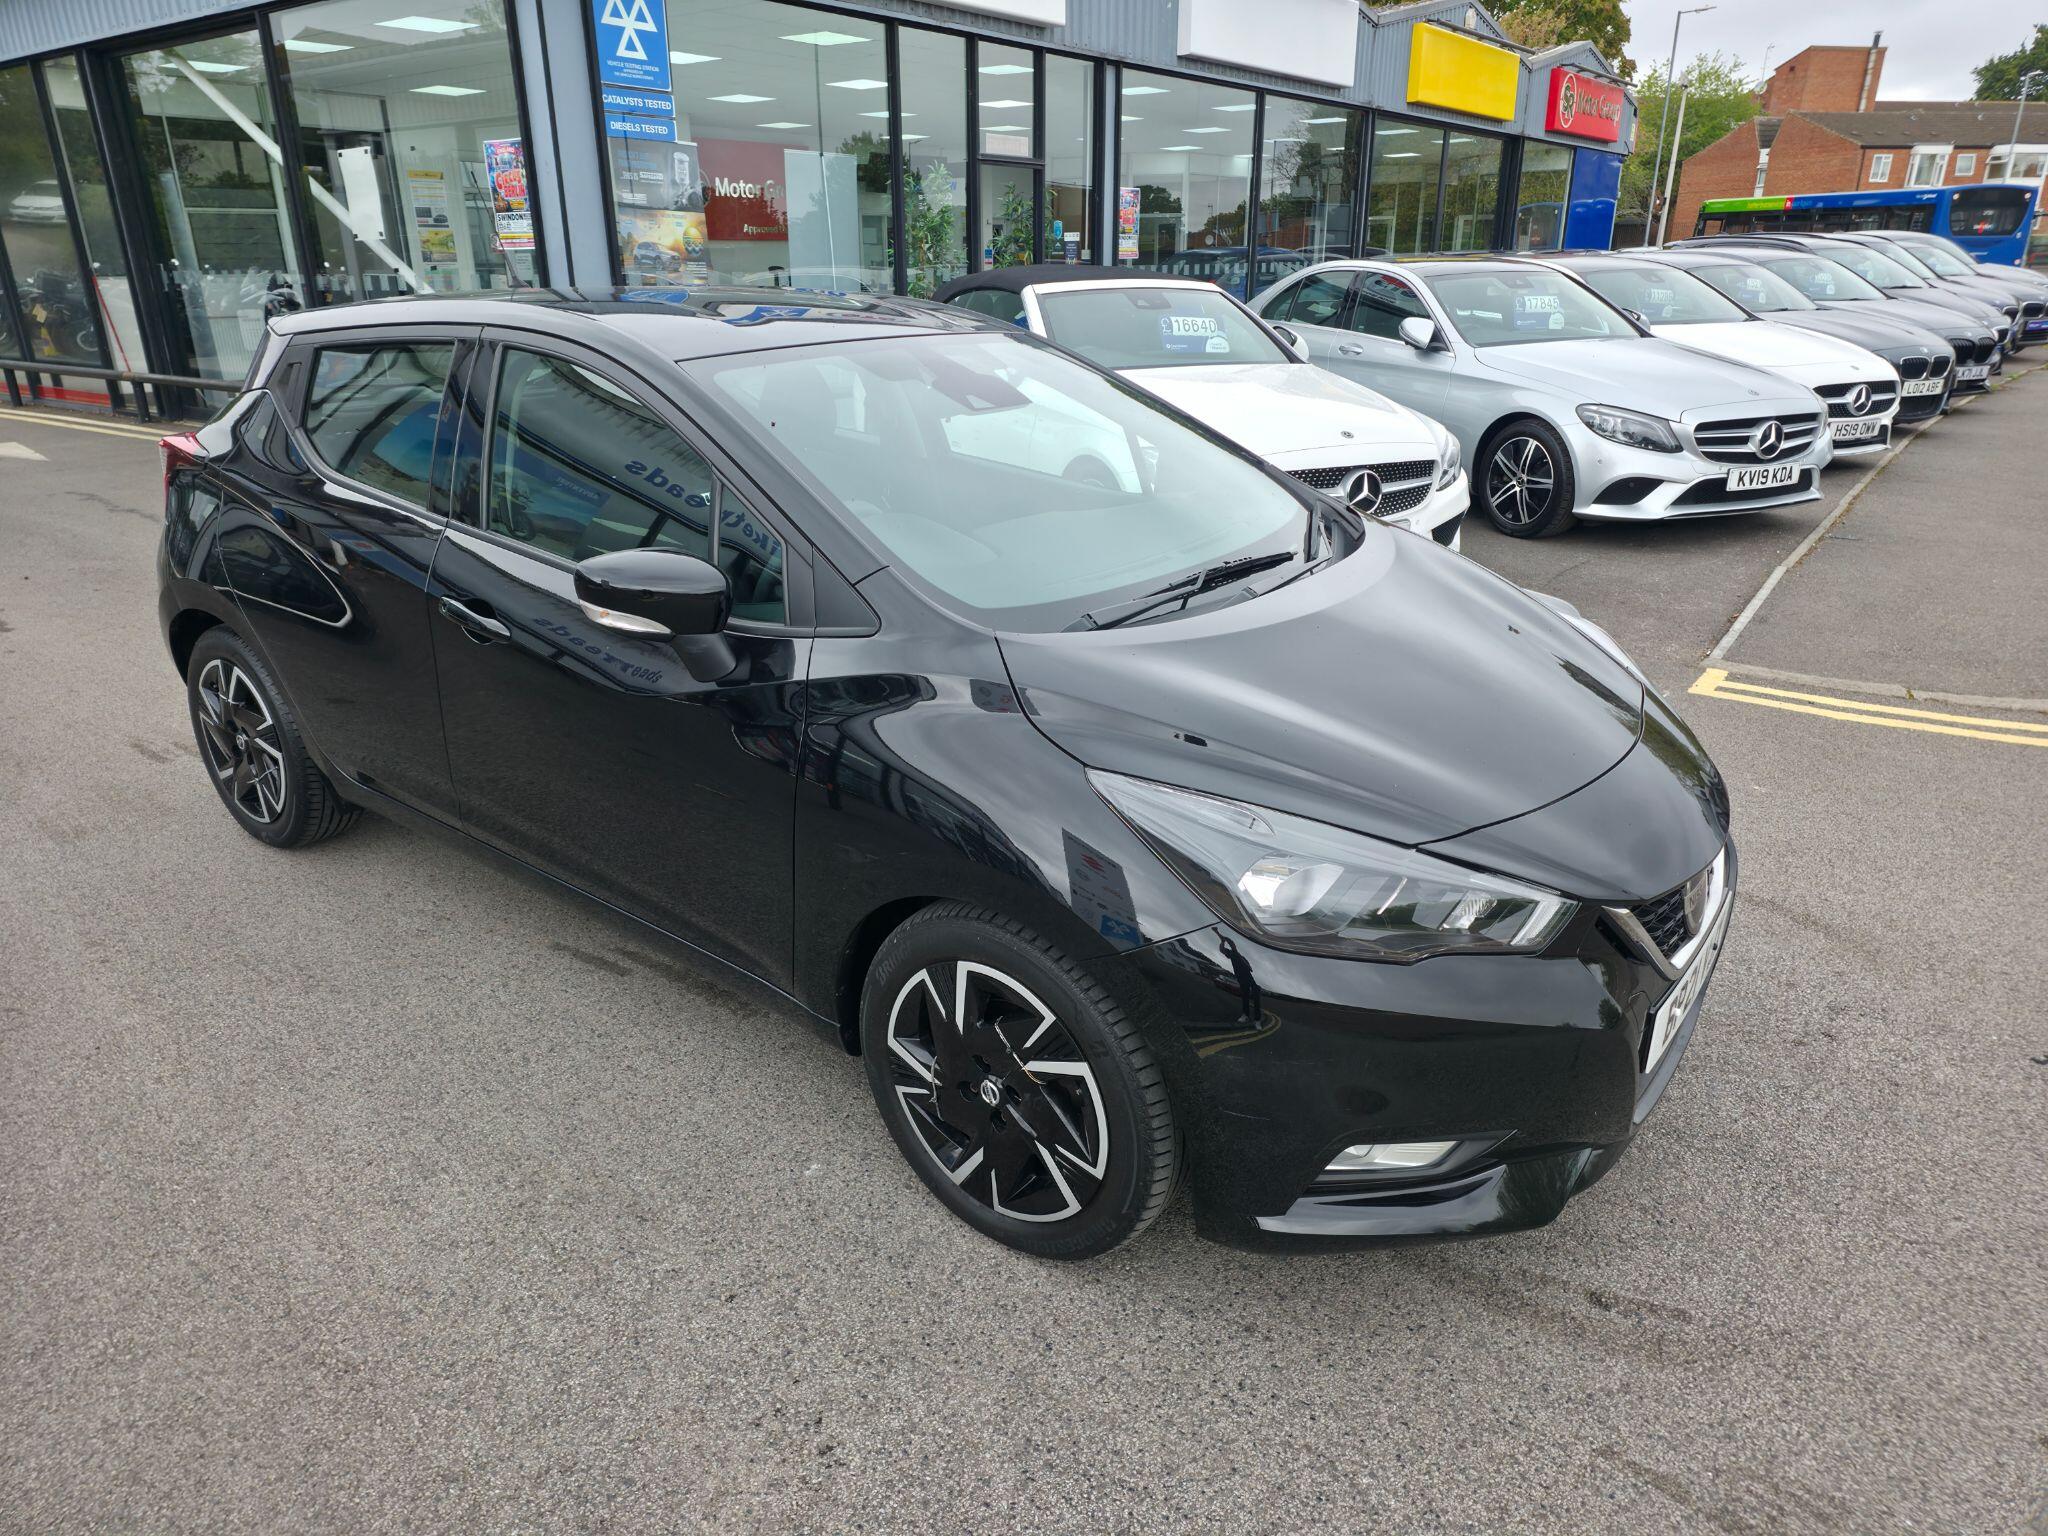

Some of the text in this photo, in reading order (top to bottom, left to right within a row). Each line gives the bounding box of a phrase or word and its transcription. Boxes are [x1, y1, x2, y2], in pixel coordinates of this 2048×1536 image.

[602, 94, 672, 110] CATALYSTS TESTED
[1576, 88, 1621, 127] Motor Group
[610, 121, 668, 135] DIESELS TESTED
[714, 177, 761, 198] Motor
[497, 213, 524, 222] SWINDON
[1906, 382, 1925, 394] LO12
[1834, 423, 1860, 437] HS19
[1737, 465, 1793, 487] KV19 KDA
